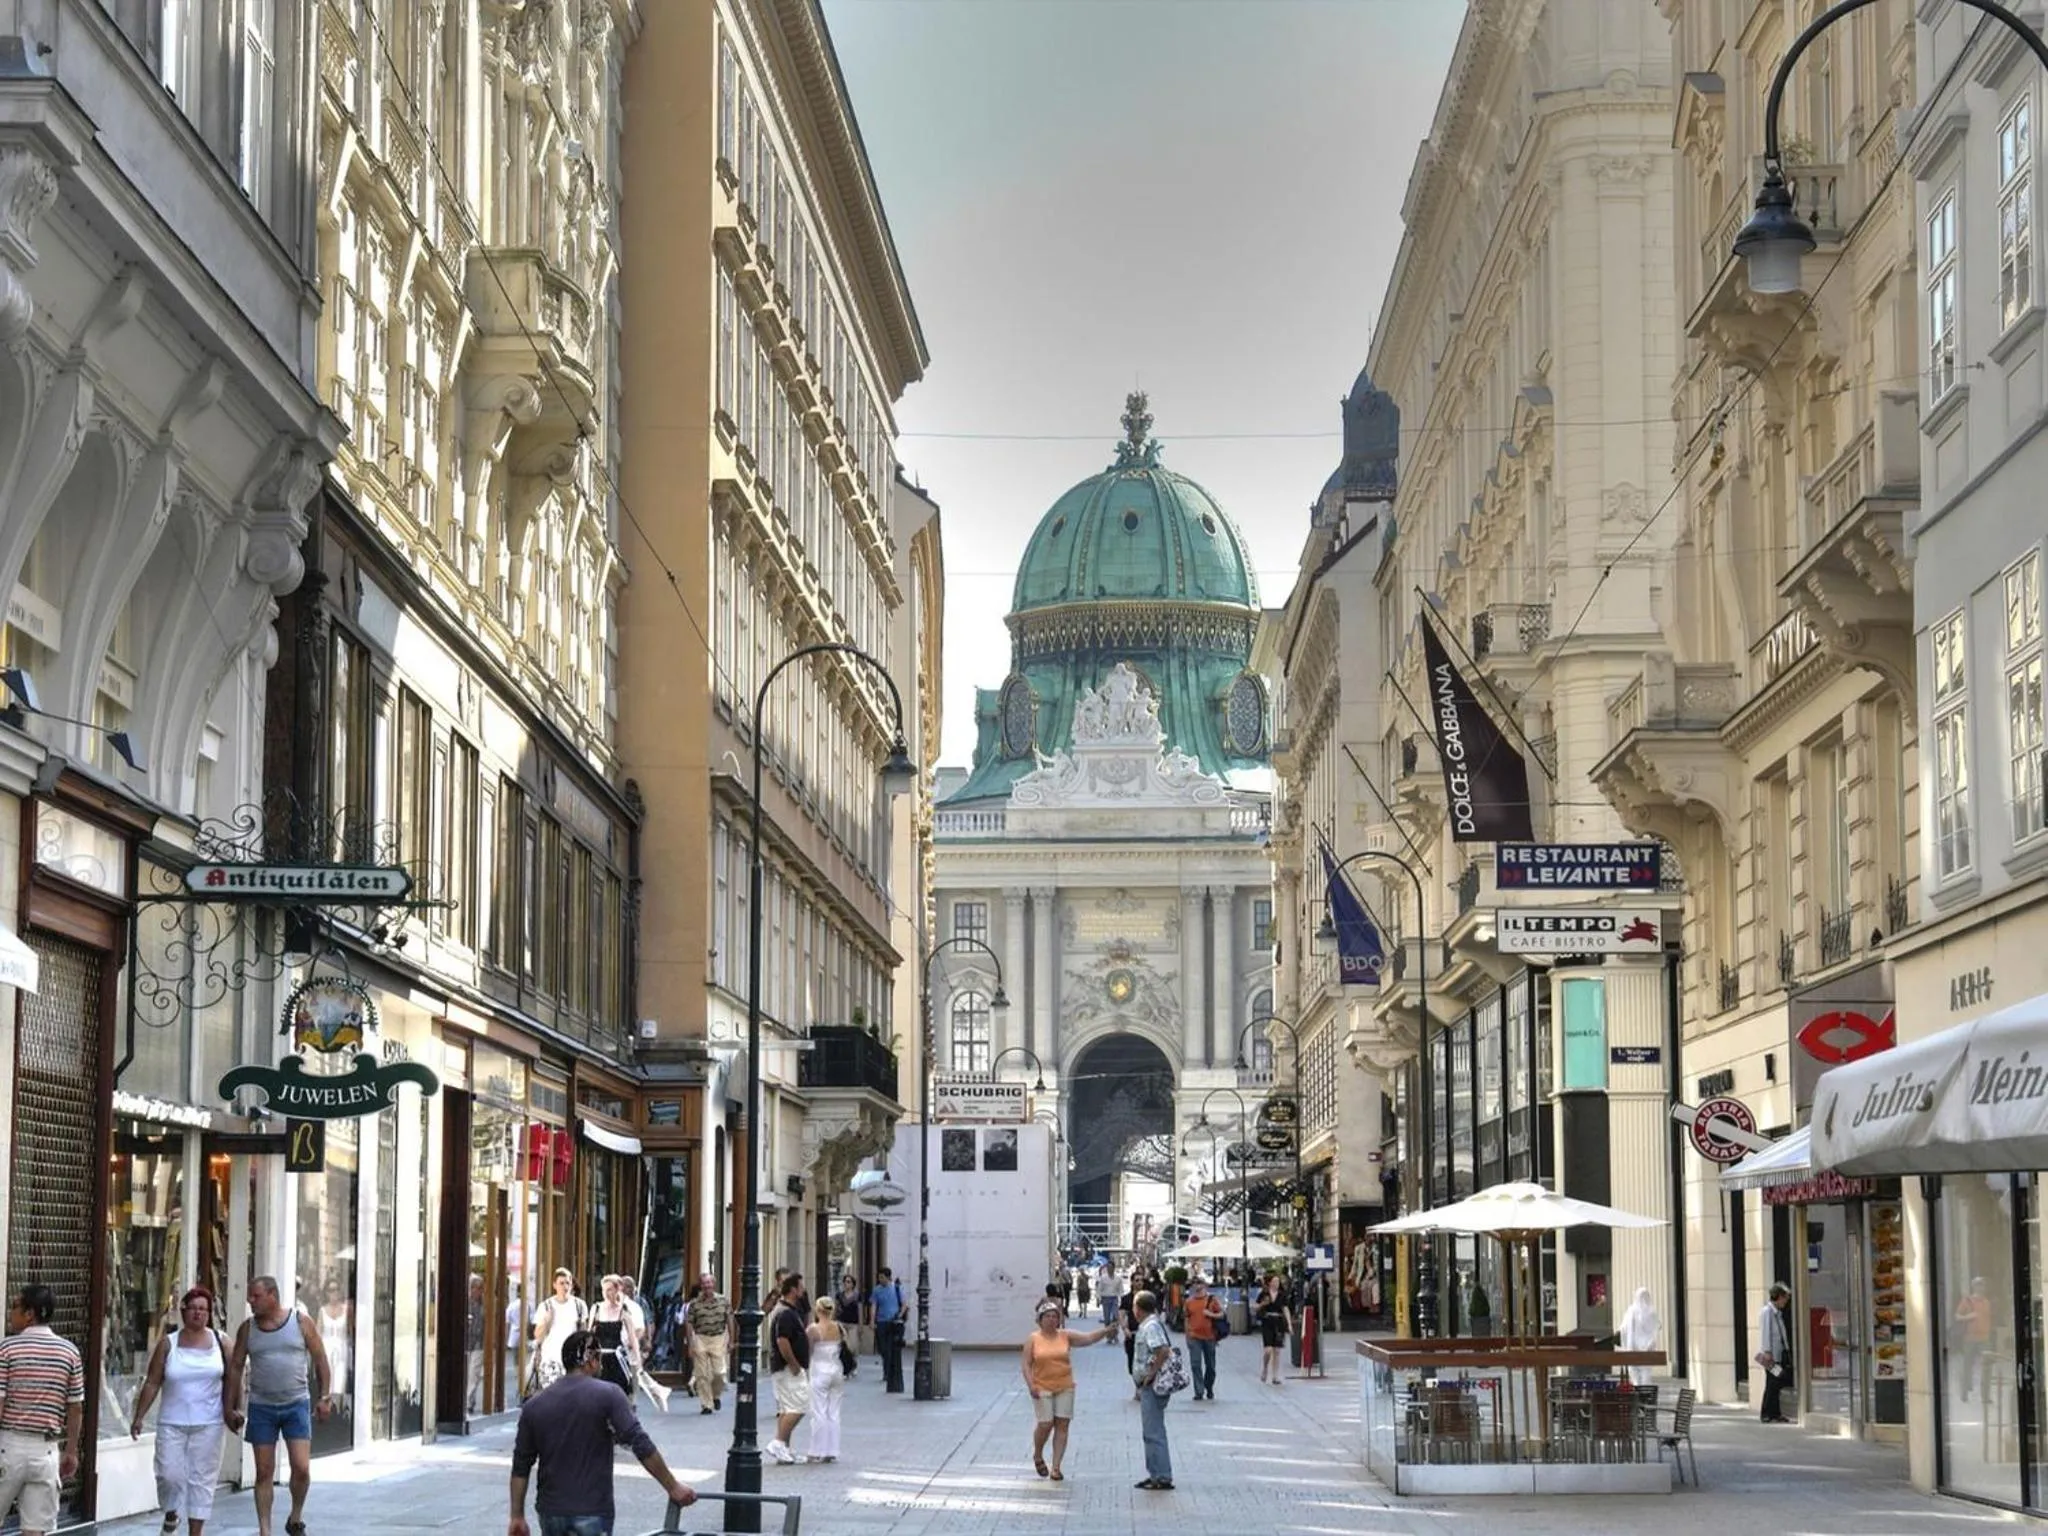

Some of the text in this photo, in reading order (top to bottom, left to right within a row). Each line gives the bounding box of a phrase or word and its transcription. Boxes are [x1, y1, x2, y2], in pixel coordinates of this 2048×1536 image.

[1436, 663, 1475, 834] DOLCE & GABBANA
[1502, 848, 1653, 863] RESTAURANT
[205, 868, 389, 891] Antiquitäten
[1527, 867, 1631, 883] LEVANTE
[1527, 918, 1613, 931] TEMPO
[1343, 955, 1382, 972] BDO
[277, 1082, 378, 1106] JUWELEN
[938, 1087, 1023, 1097] SCHUBRIG
[1853, 1072, 1937, 1128] Julius
[1696, 1101, 1751, 1128] AUSTRIA
[1698, 1134, 1741, 1158] TABAK
